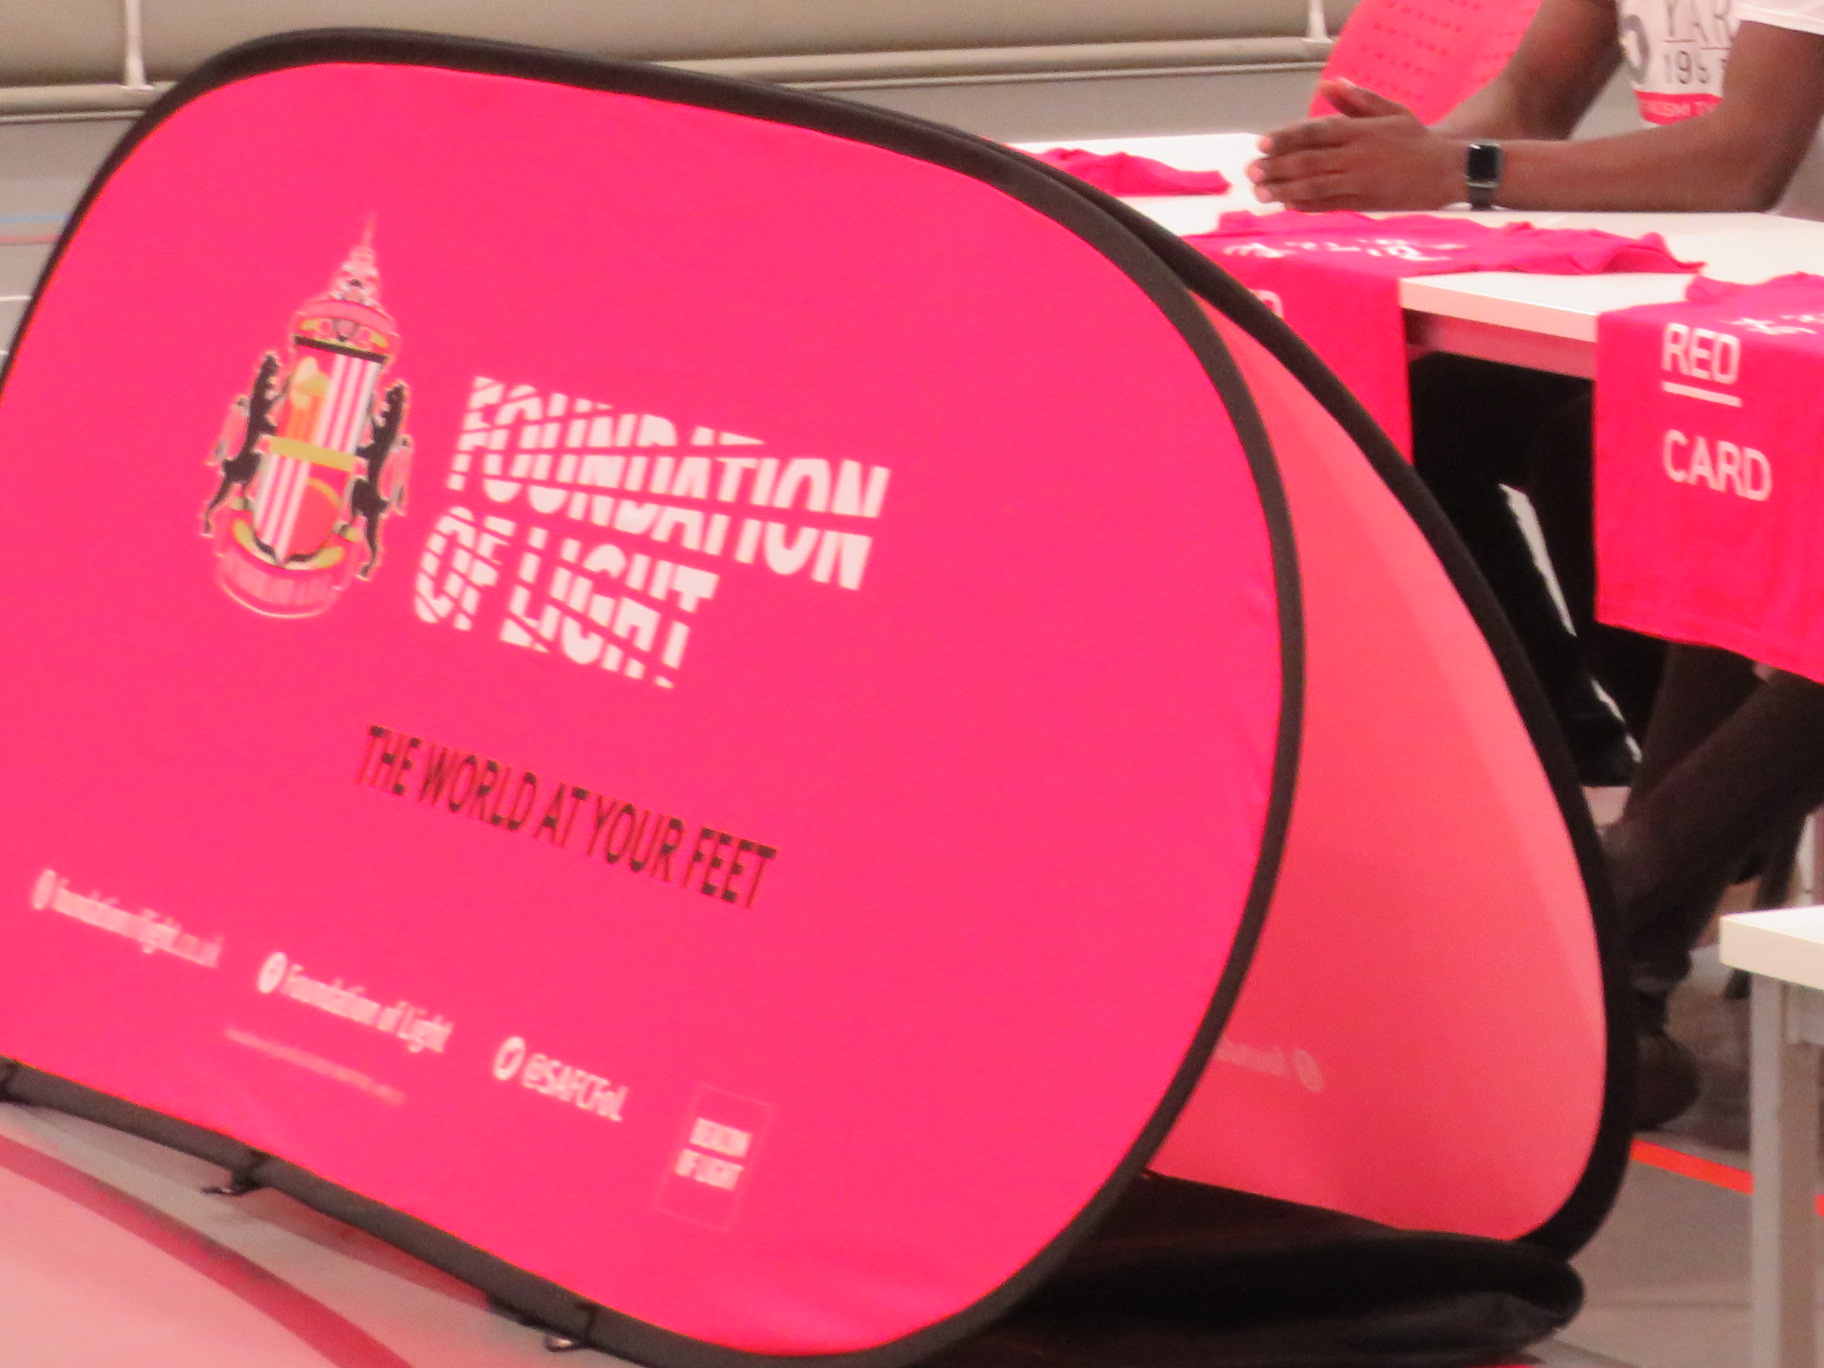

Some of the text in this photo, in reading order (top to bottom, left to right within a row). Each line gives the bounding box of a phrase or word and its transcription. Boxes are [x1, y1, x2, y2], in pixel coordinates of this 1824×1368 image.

[1661, 322, 1741, 384] RED
[447, 376, 891, 591] FOUNDATION
[1662, 429, 1773, 502] CARD
[412, 506, 517, 632] OF
[500, 528, 720, 689] LIGHT
[357, 724, 778, 909] THE WORLD AT YOUR FEET
